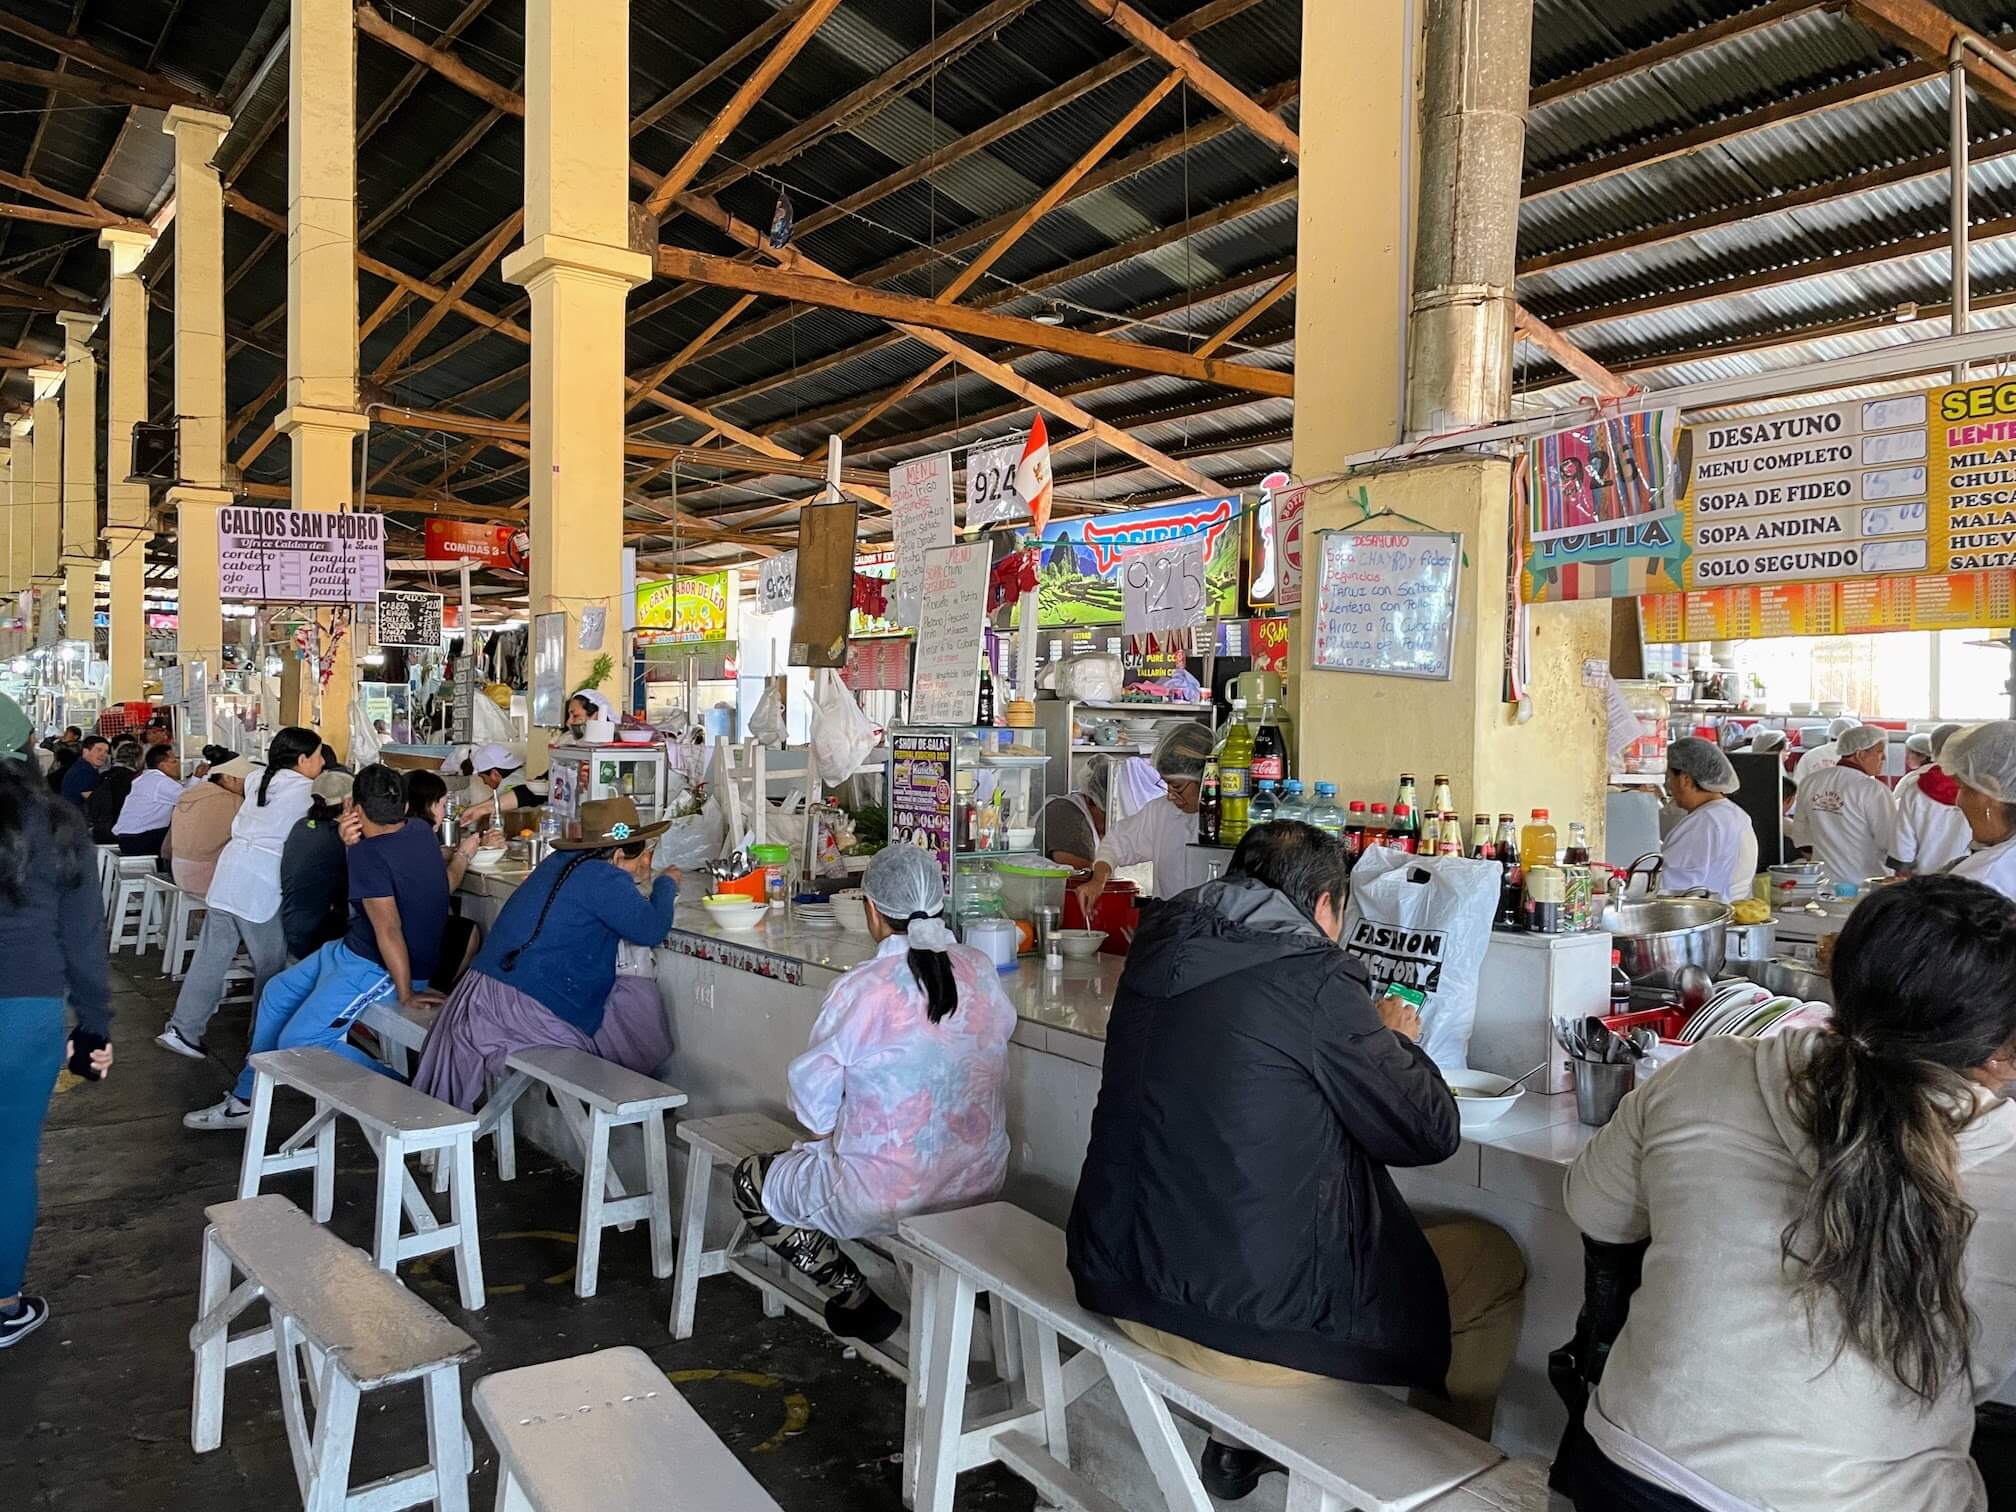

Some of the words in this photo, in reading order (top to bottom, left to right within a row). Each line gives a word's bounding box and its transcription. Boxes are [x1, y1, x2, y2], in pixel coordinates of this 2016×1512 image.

[1941, 382, 2016, 421] SEG
[1708, 413, 1841, 449] DESAYUNO
[1948, 421, 2016, 447] LENTE
[1698, 459, 1749, 479] MENU
[1753, 445, 1852, 471] COMPLETO
[975, 464, 1017, 504] 924
[1950, 471, 2016, 488] CHUL
[1699, 492, 1750, 512] SOPA
[1754, 488, 1782, 506] DE
[1787, 480, 1852, 502] FIDEO
[221, 509, 286, 537] CALDOS
[291, 513, 323, 538] SAN
[327, 514, 378, 540] PEDRO
[1950, 512, 2016, 529] MALA
[1699, 526, 1750, 544] SOPA
[1755, 516, 1842, 539] ANDINA
[444, 541, 490, 555] COMIDAS
[1352, 535, 1410, 548] DESAYUNO
[1951, 532, 2016, 549] HUEV
[222, 550, 275, 560] cordero
[309, 553, 356, 566] lengua
[1699, 559, 1750, 577] SOLO
[1754, 550, 1858, 573] SEGUNDO
[222, 561, 271, 571] cabeza
[222, 572, 244, 584] ojo
[1127, 550, 1201, 615] 925
[223, 584, 259, 595] oreja
[309, 587, 351, 597] panza
[396, 593, 427, 602] CALDOS
[649, 586, 670, 609] GRAN
[673, 581, 696, 595] ABOR
[697, 583, 709, 598] DE
[709, 588, 725, 611] LEO
[1329, 618, 1360, 634] Arroz
[1354, 923, 1442, 956] FASHION
